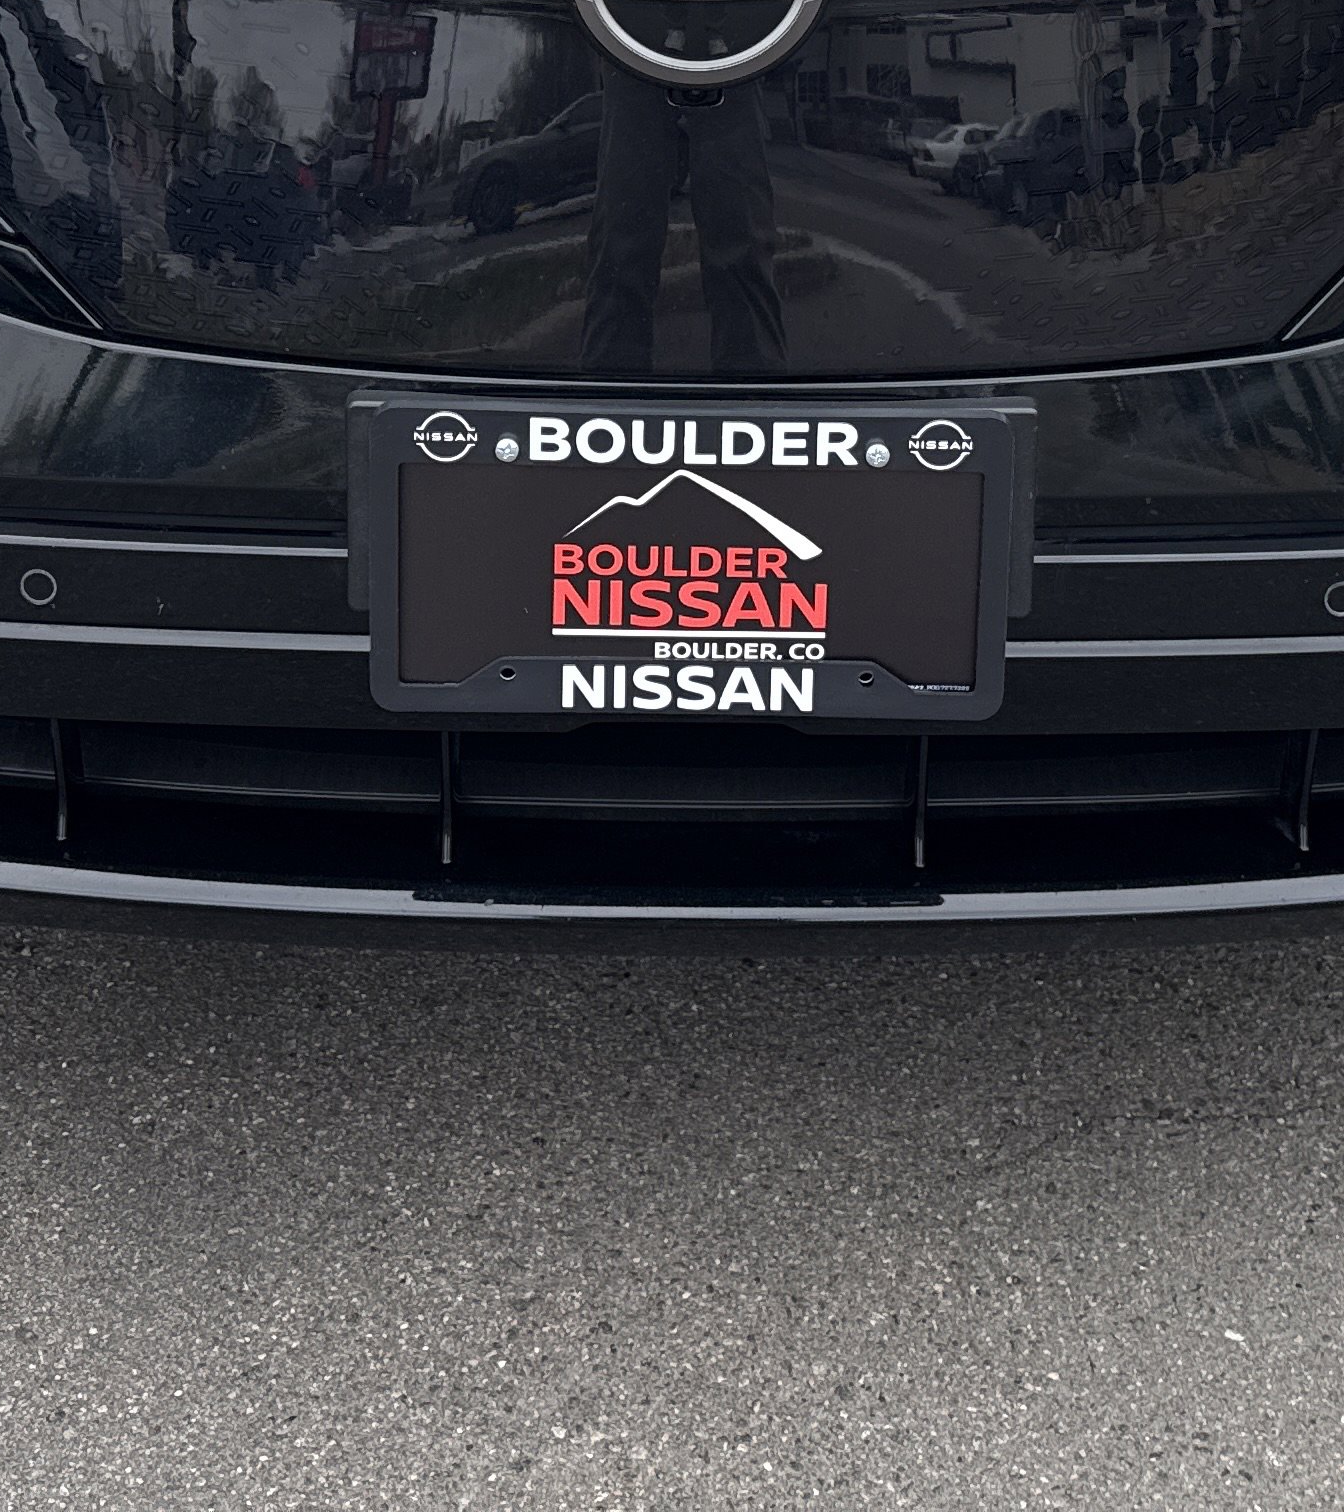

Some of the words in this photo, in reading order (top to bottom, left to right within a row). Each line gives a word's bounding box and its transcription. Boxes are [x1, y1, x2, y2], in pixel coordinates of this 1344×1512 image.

[413, 431, 478, 442] NISSAN
[529, 416, 859, 466] BOULDER
[908, 440, 973, 451] NISSAN
[553, 543, 789, 579] BOULDER
[552, 578, 829, 629] NISSAN
[788, 643, 825, 660] CO
[561, 664, 814, 712] NISSAN
